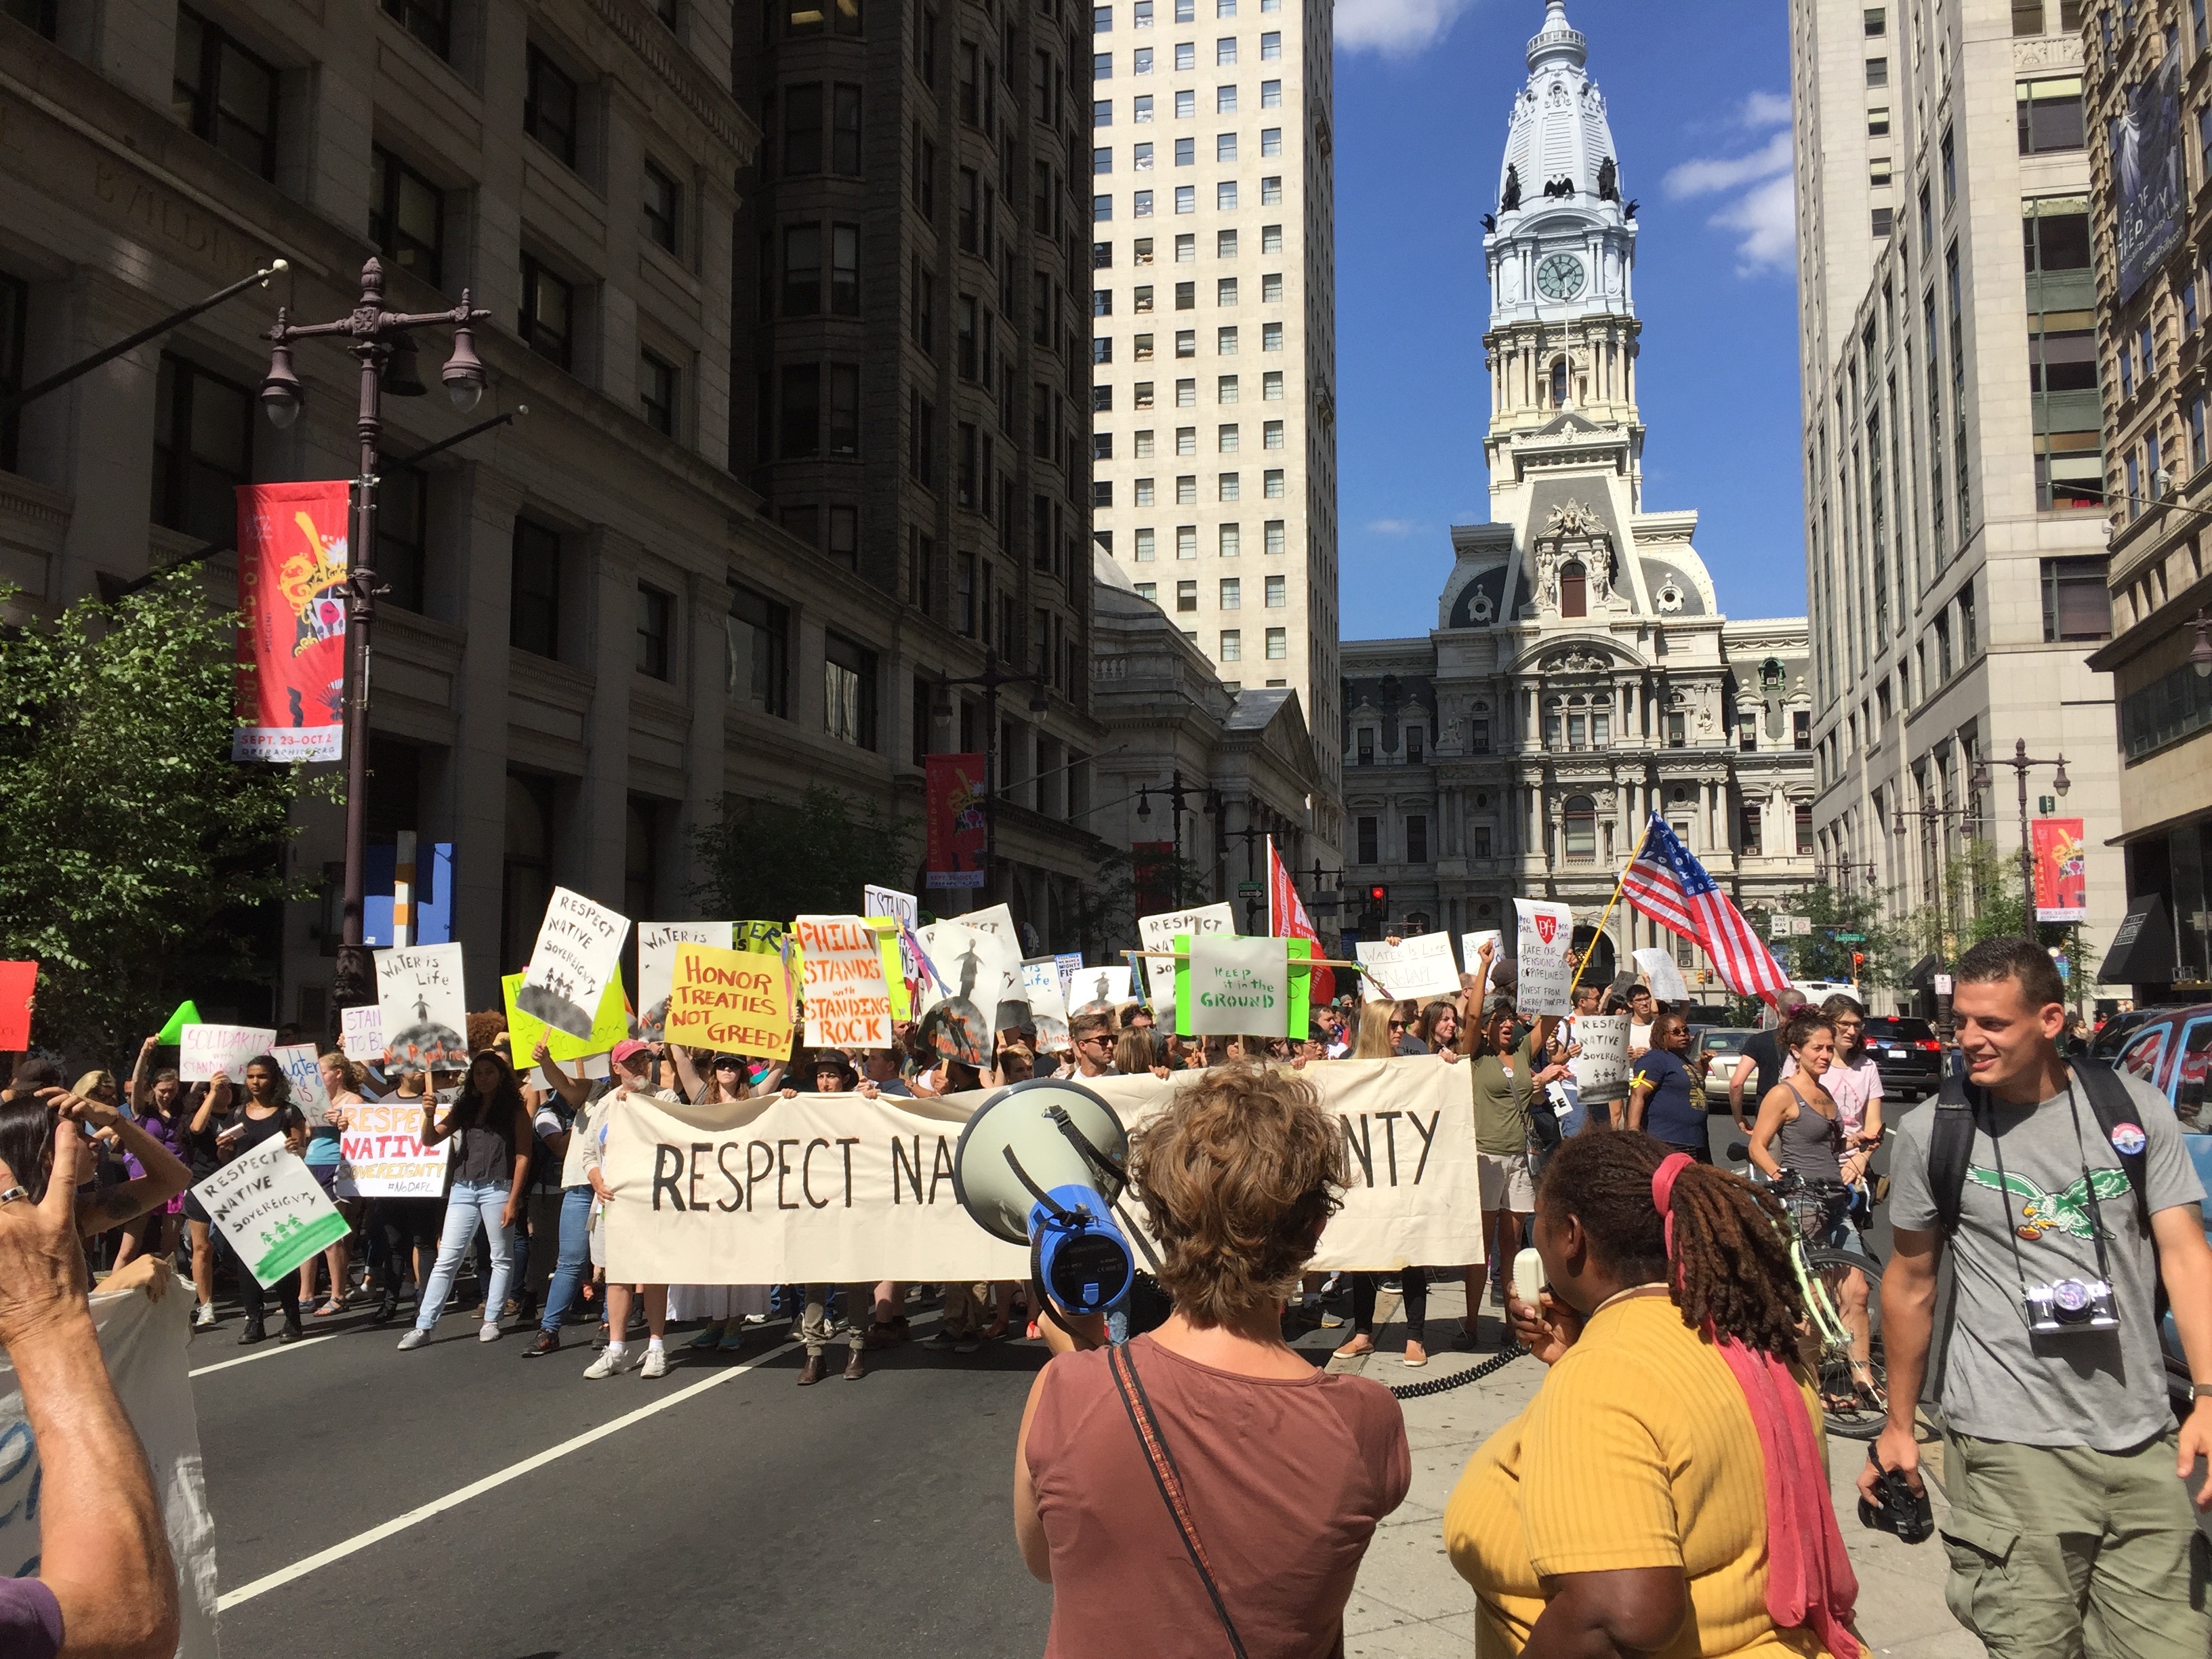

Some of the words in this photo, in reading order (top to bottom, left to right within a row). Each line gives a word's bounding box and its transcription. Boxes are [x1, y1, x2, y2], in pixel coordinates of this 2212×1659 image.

[241, 735, 276, 745] SEPT.
[325, 734, 332, 743] 2
[560, 895, 615, 939] RESPECT
[877, 892, 912, 926] STAND
[1149, 915, 1223, 933] RESPCT
[1519, 925, 1534, 933] DAPL
[548, 917, 592, 950] NATIVE
[643, 926, 688, 950] WATER
[1556, 932, 1571, 940] DAPL
[1364, 946, 1404, 962] WATER
[1521, 943, 1541, 955] TAKE
[1544, 946, 1561, 957] OUR
[381, 954, 422, 979] WATER
[544, 940, 596, 996] SOVEREIGNTY
[1521, 954, 1555, 967] PENSIONS
[415, 970, 449, 985] Life
[685, 955, 772, 996] HONOR
[804, 958, 880, 985] STANDS
[1531, 968, 1564, 980] PIPELINES
[832, 986, 855, 997] with
[1223, 979, 1232, 989] it
[1237, 981, 1248, 989] in
[1250, 979, 1274, 993] the
[1519, 983, 1541, 996] DIVEST
[1544, 987, 1561, 996] FROM
[676, 986, 777, 1015] TREATIES
[1200, 991, 1275, 1008] GROUND
[1521, 997, 1543, 1007] ENERGY
[804, 997, 890, 1021] STANDING
[672, 1010, 714, 1027] NOT
[1582, 1019, 1629, 1032] RESPECT
[707, 1022, 792, 1052] GREED!
[819, 1018, 882, 1045] ROCK
[188, 1029, 274, 1056] SOLIDARITY
[347, 1036, 367, 1053] TO
[1579, 1035, 1619, 1048] NATIVE
[204, 1151, 279, 1198] RESPECT
[339, 1162, 446, 1181] SOVEREIGNTY
[653, 1136, 860, 1212] RESPECT
[891, 1134, 963, 1205] NA
[388, 1181, 434, 1193] #NoDAPL
[213, 1175, 273, 1222] NATIVE
